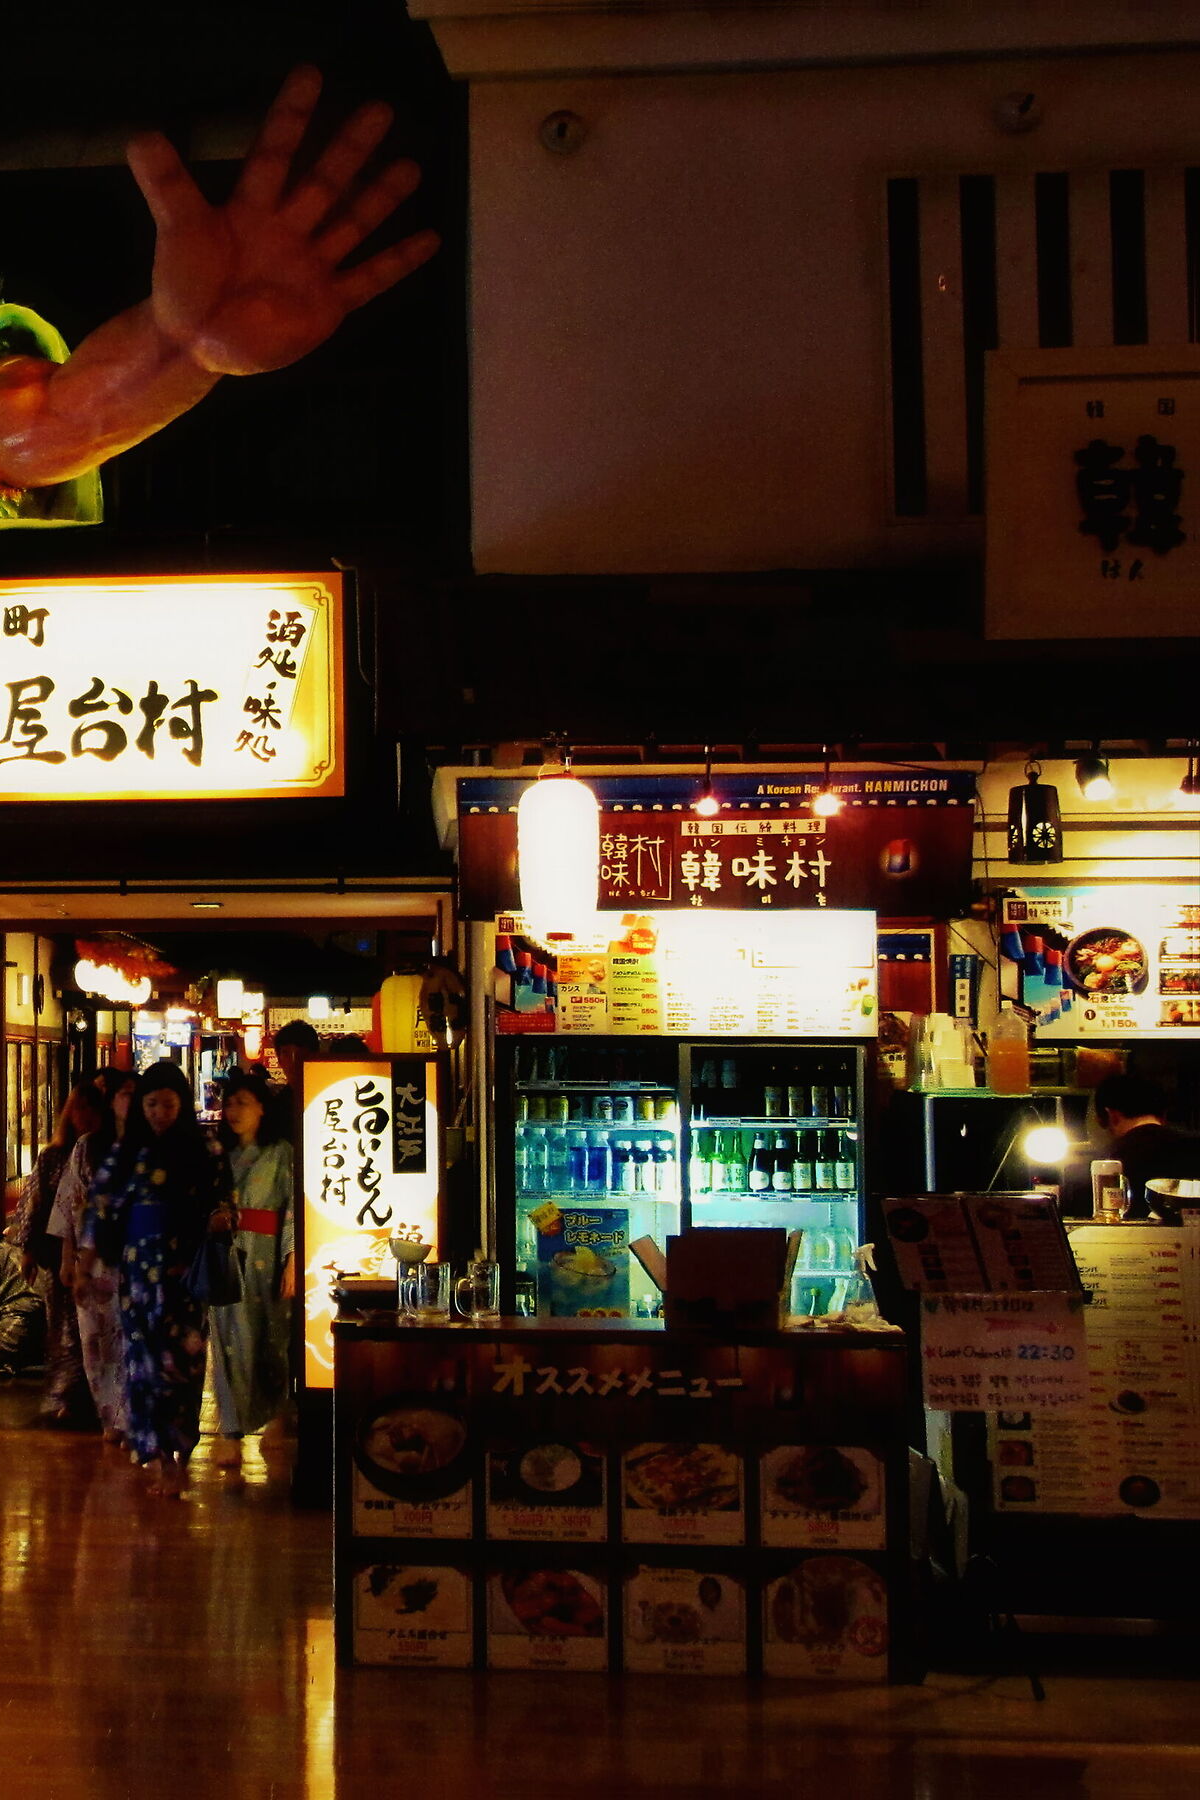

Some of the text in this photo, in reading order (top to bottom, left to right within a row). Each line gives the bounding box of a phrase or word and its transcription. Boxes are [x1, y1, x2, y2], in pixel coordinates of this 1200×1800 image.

[757, 780, 948, 795] A Korean Resurant. HANMICHON
[687, 822, 821, 834] 韓国伝統料理
[680, 850, 833, 892] 韓味村
[395, 1083, 425, 1165] 大江戸
[320, 1099, 349, 1207] 屋台村
[352, 1080, 393, 1227] 旨いもん
[565, 1213, 602, 1228] ブルー
[564, 1230, 625, 1245] レモネード
[1017, 1344, 1075, 1360] 22:30
[491, 1355, 744, 1398] オススメメニュー
